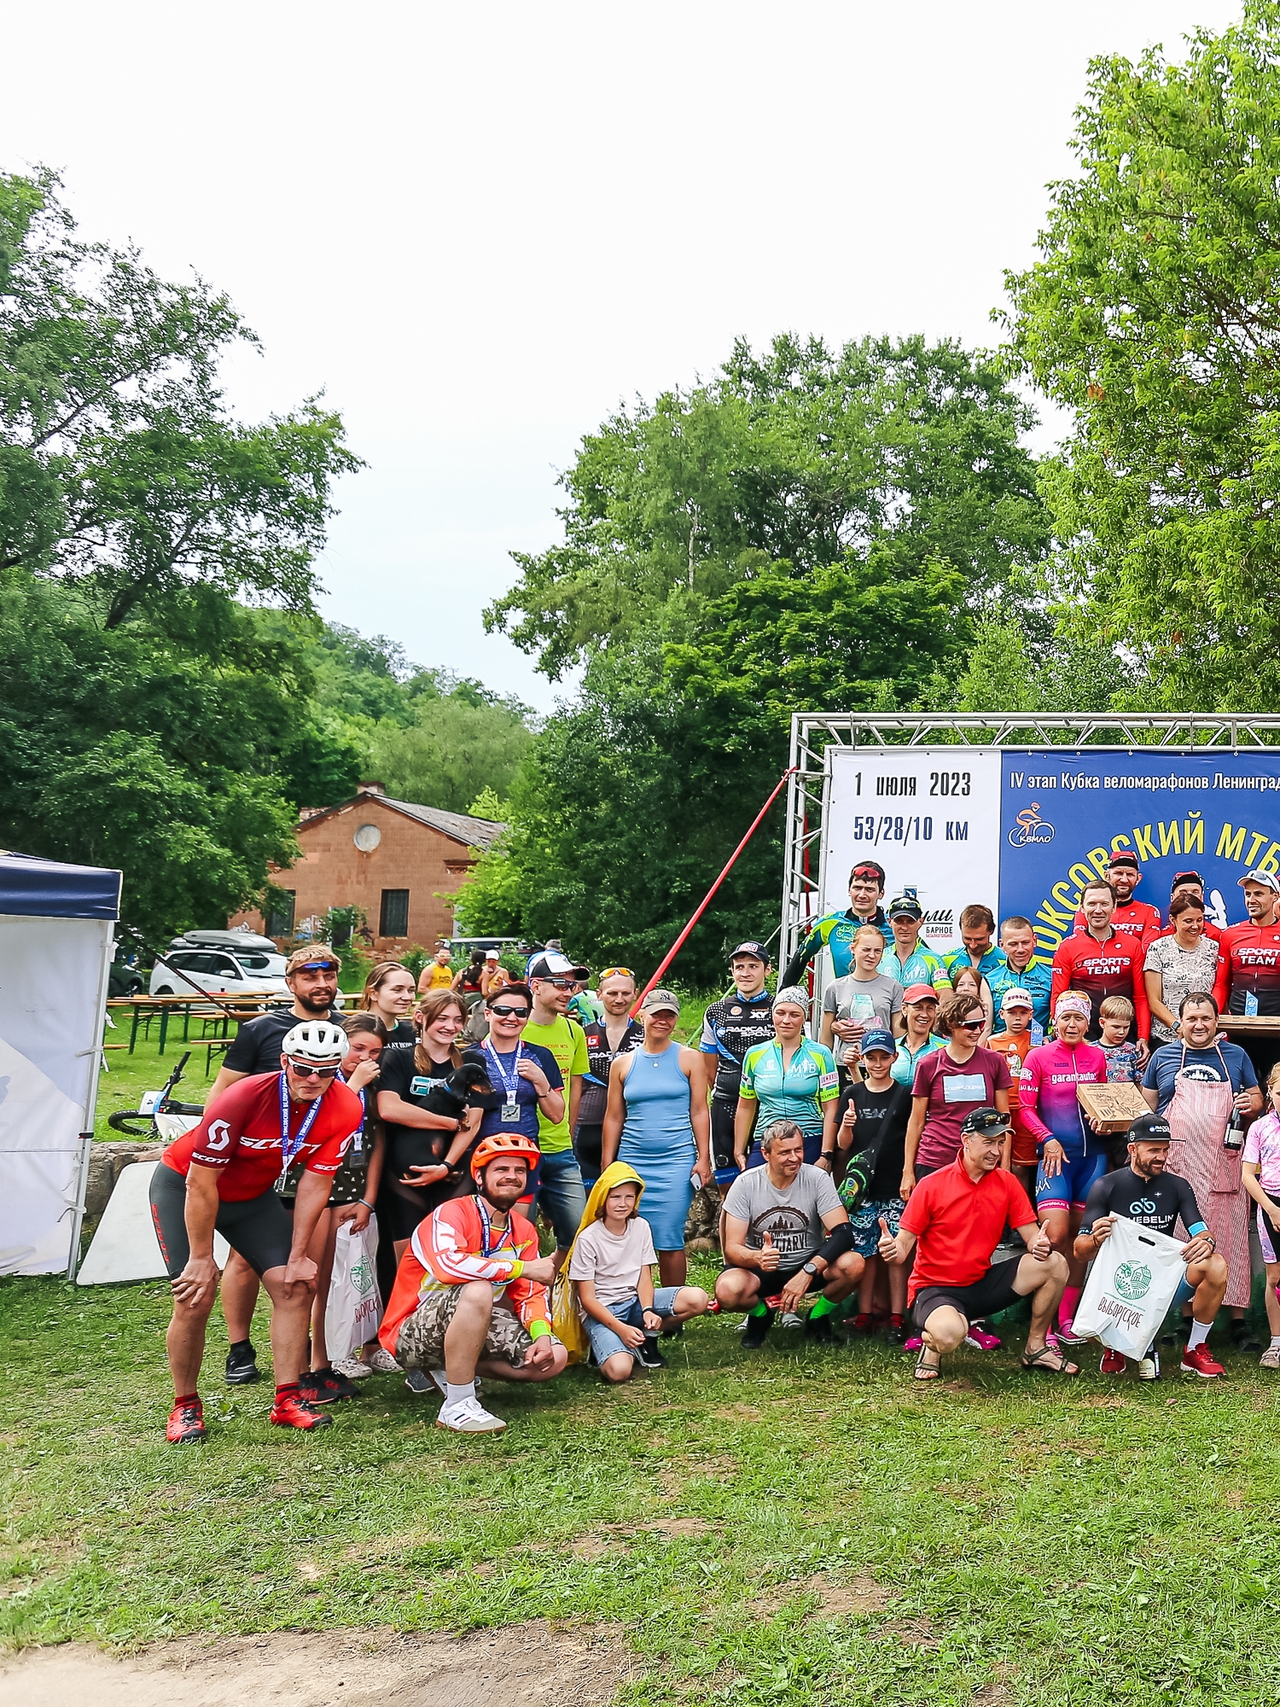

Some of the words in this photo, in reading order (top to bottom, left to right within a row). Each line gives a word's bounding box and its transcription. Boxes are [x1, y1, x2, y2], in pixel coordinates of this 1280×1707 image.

[854, 772, 861, 796] 1
[876, 776, 917, 796] июля
[929, 772, 971, 796] 2023
[1010, 772, 1025, 788] IV
[1028, 775, 1057, 789] этап
[1061, 772, 1100, 791] Кубка
[1104, 772, 1209, 792] веломарафонов
[854, 816, 933, 847] 53/28/10
[925, 926, 953, 934] БАРНОЕ
[1082, 957, 1131, 967] SPORTS
[1240, 956, 1276, 966] TEAM
[1087, 965, 1120, 975] TEAM
[1097, 1296, 1144, 1331] ВЫБОРГСКОЕ
